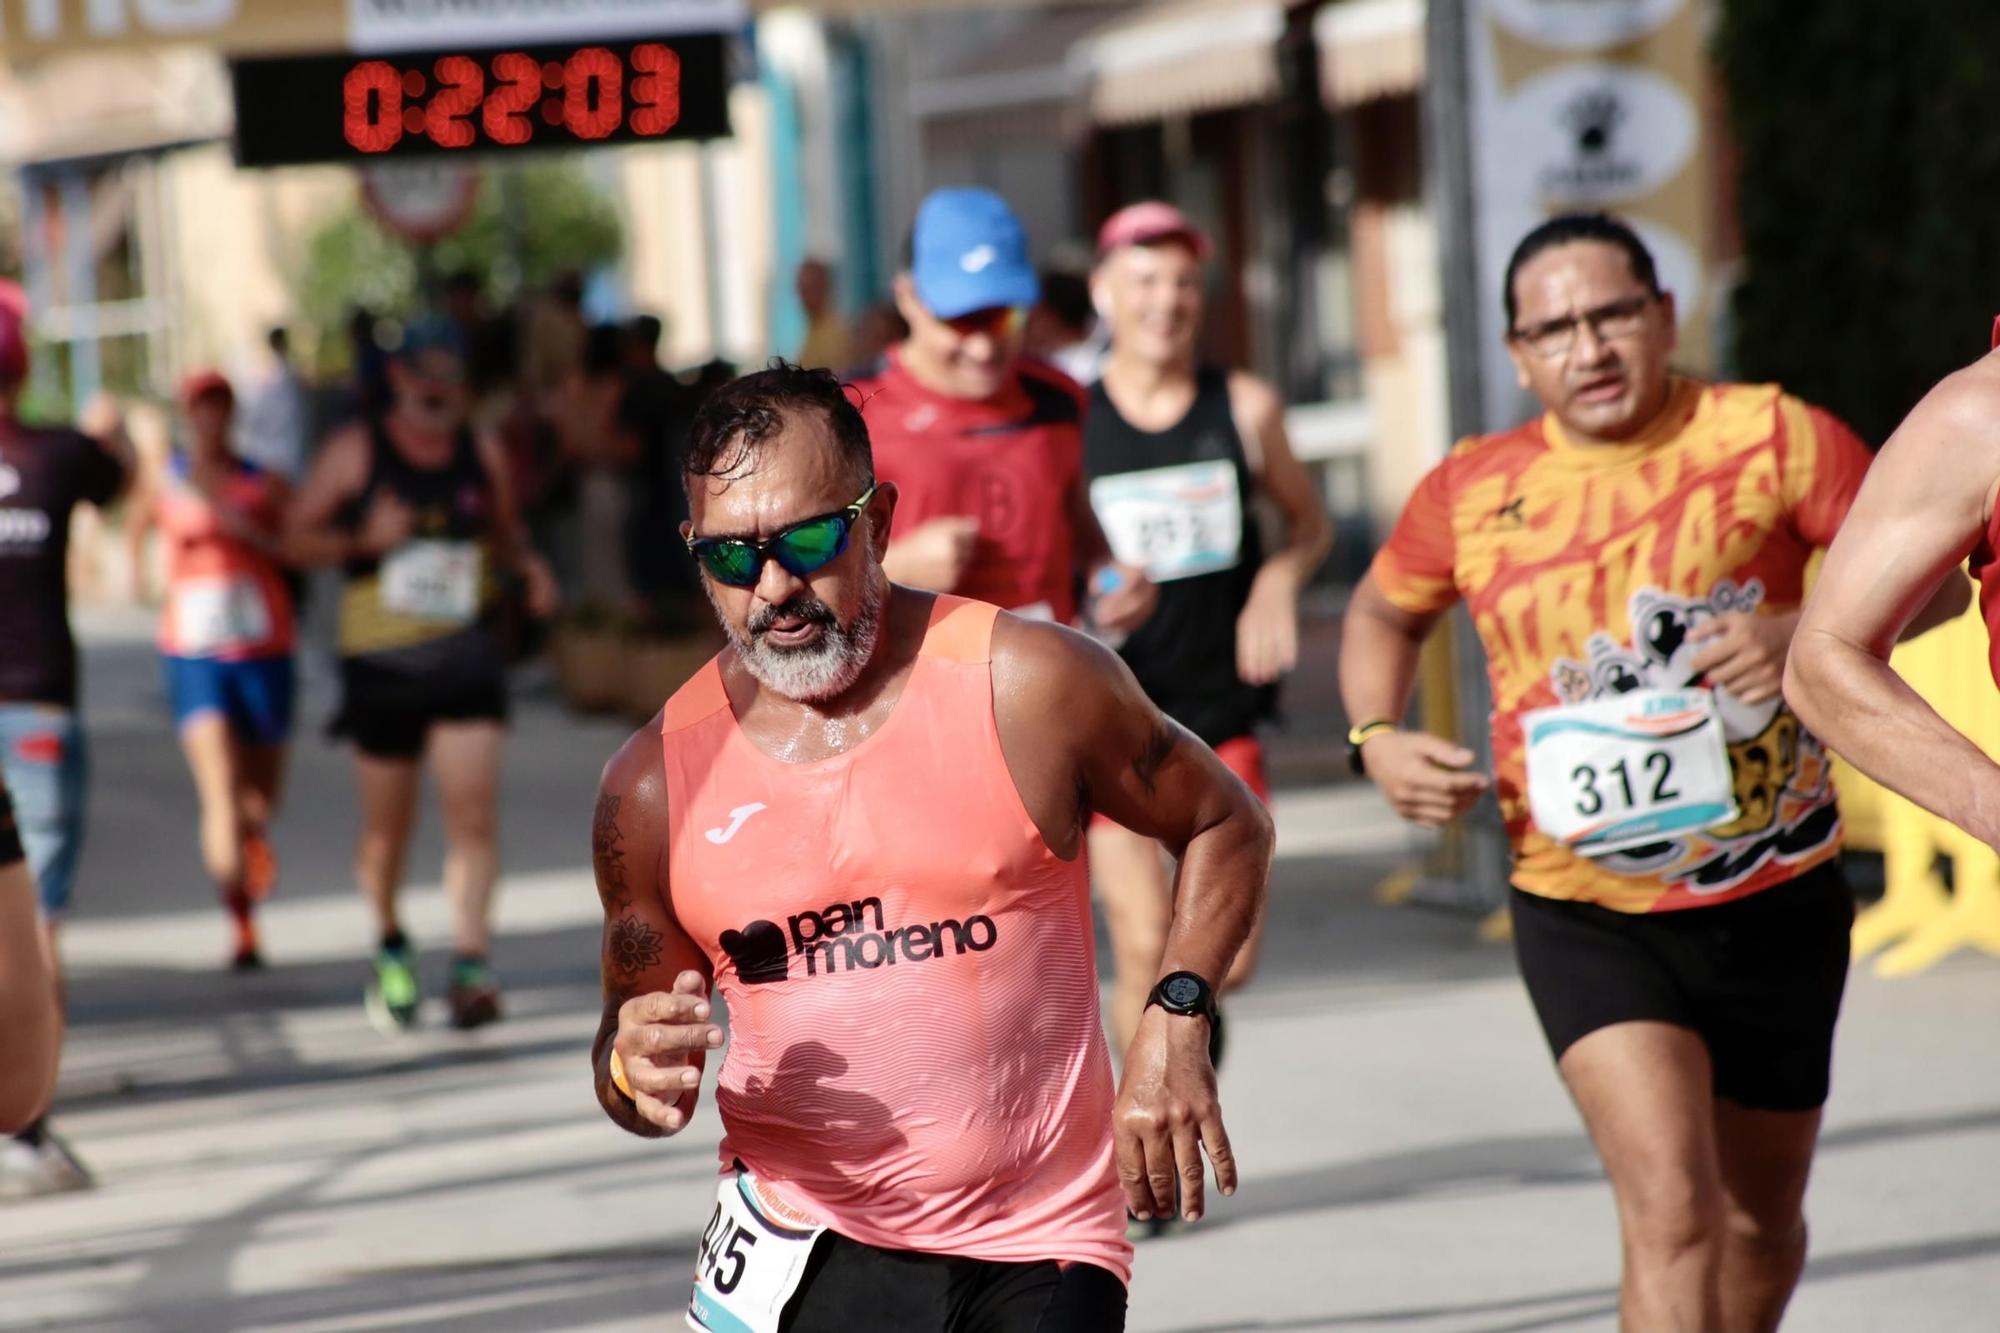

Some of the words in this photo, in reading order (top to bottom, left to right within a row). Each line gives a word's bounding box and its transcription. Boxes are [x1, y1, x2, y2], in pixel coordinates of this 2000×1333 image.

[343, 43, 681, 153] 0:22:03
[1572, 752, 1681, 816] 312
[787, 896, 884, 955] pan
[803, 914, 998, 977] moreno
[700, 1200, 758, 1295] 445
